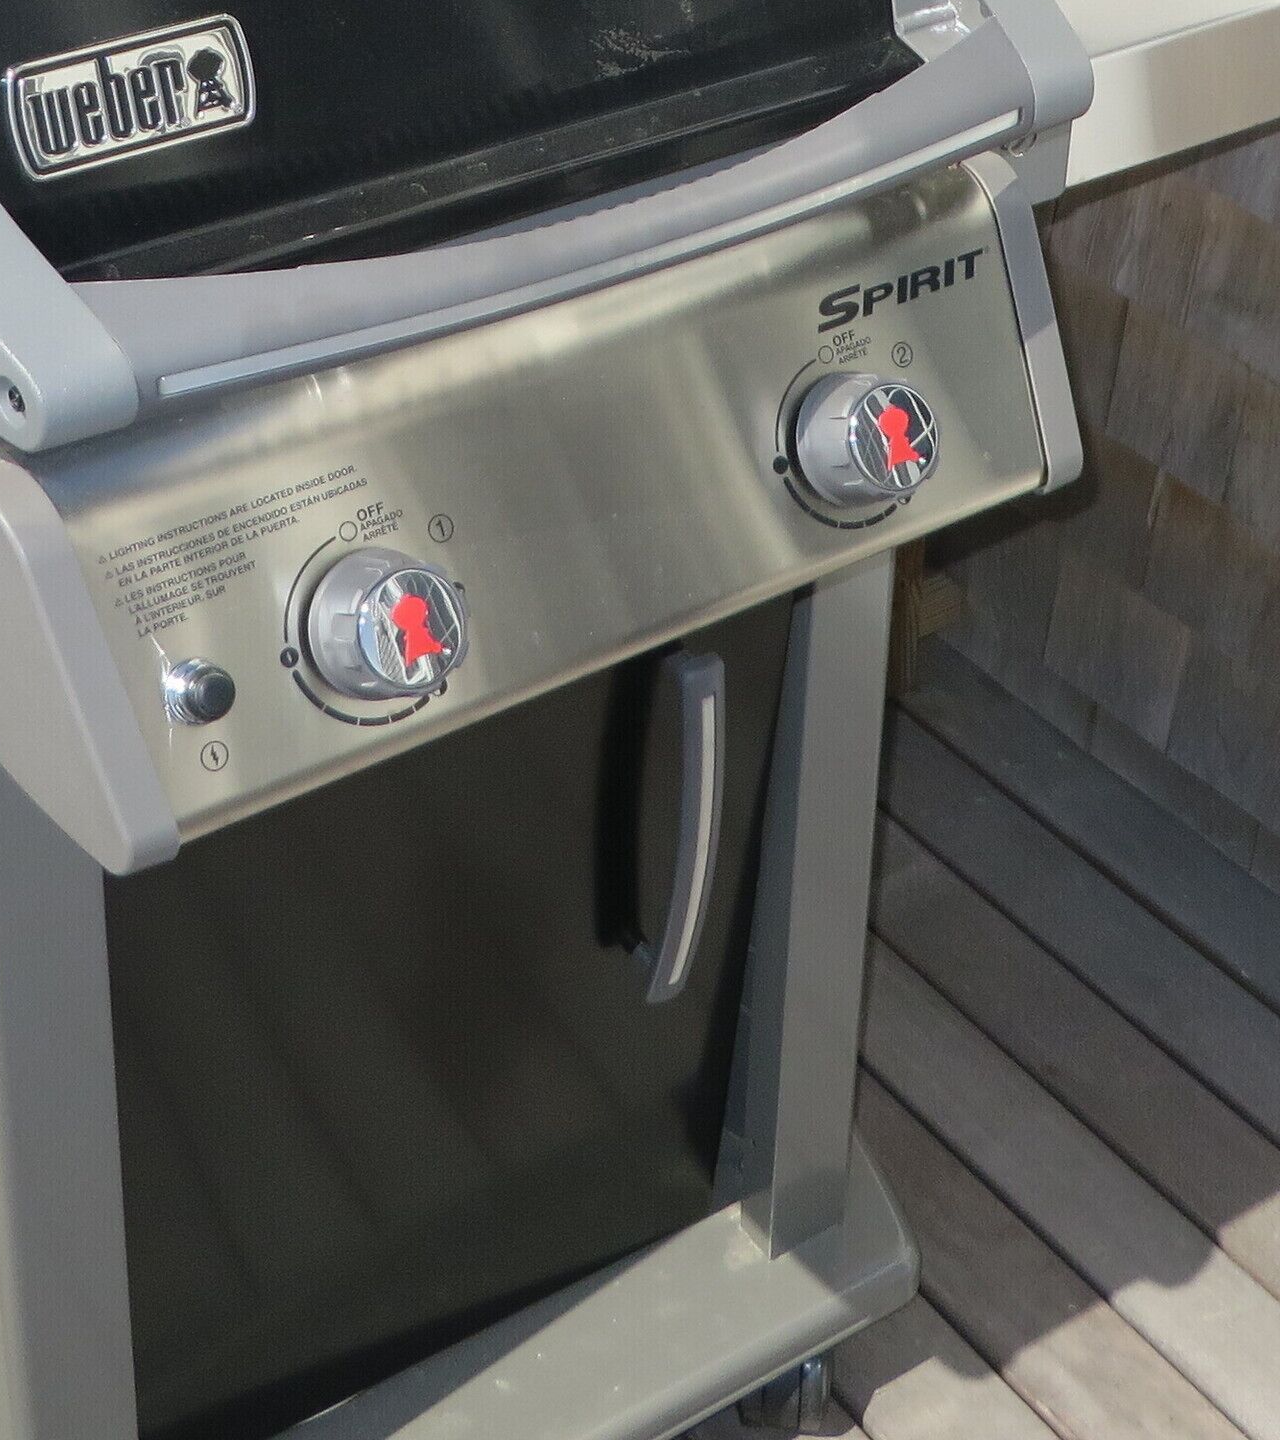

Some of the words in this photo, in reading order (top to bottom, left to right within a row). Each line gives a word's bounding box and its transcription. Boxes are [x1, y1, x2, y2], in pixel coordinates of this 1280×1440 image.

[25, 56, 187, 157] weber
[817, 249, 984, 333] SPIRIT
[832, 330, 855, 347] OFF
[836, 337, 871, 355] APAGADO
[109, 537, 156, 561] LIGHTING
[157, 511, 228, 543] INSTRUCTIONS
[230, 503, 249, 518] ARE
[250, 487, 294, 509] LOCATED
[296, 476, 327, 493] INSIDE
[115, 562, 135, 576] LAS
[137, 532, 216, 567] INSTRUCCIONES
[217, 527, 231, 540] DE
[232, 506, 288, 533] ENCENDIDO
[321, 478, 368, 501] UBICADAS
[357, 502, 384, 521] OFF
[360, 509, 404, 532] APAGADO
[119, 577, 132, 587] EN
[135, 571, 148, 581] LA
[150, 558, 181, 576] PARTE
[183, 541, 228, 563] INTERIOR
[230, 535, 245, 547] DE
[246, 530, 259, 541] LA
[125, 589, 144, 603] LES
[145, 562, 217, 595] INSTRUCTIONS
[219, 551, 247, 567] POUR
[190, 580, 204, 592] SE
[205, 560, 256, 585] TROUVENT
[206, 585, 226, 600] SUR
[138, 626, 151, 638] LA
